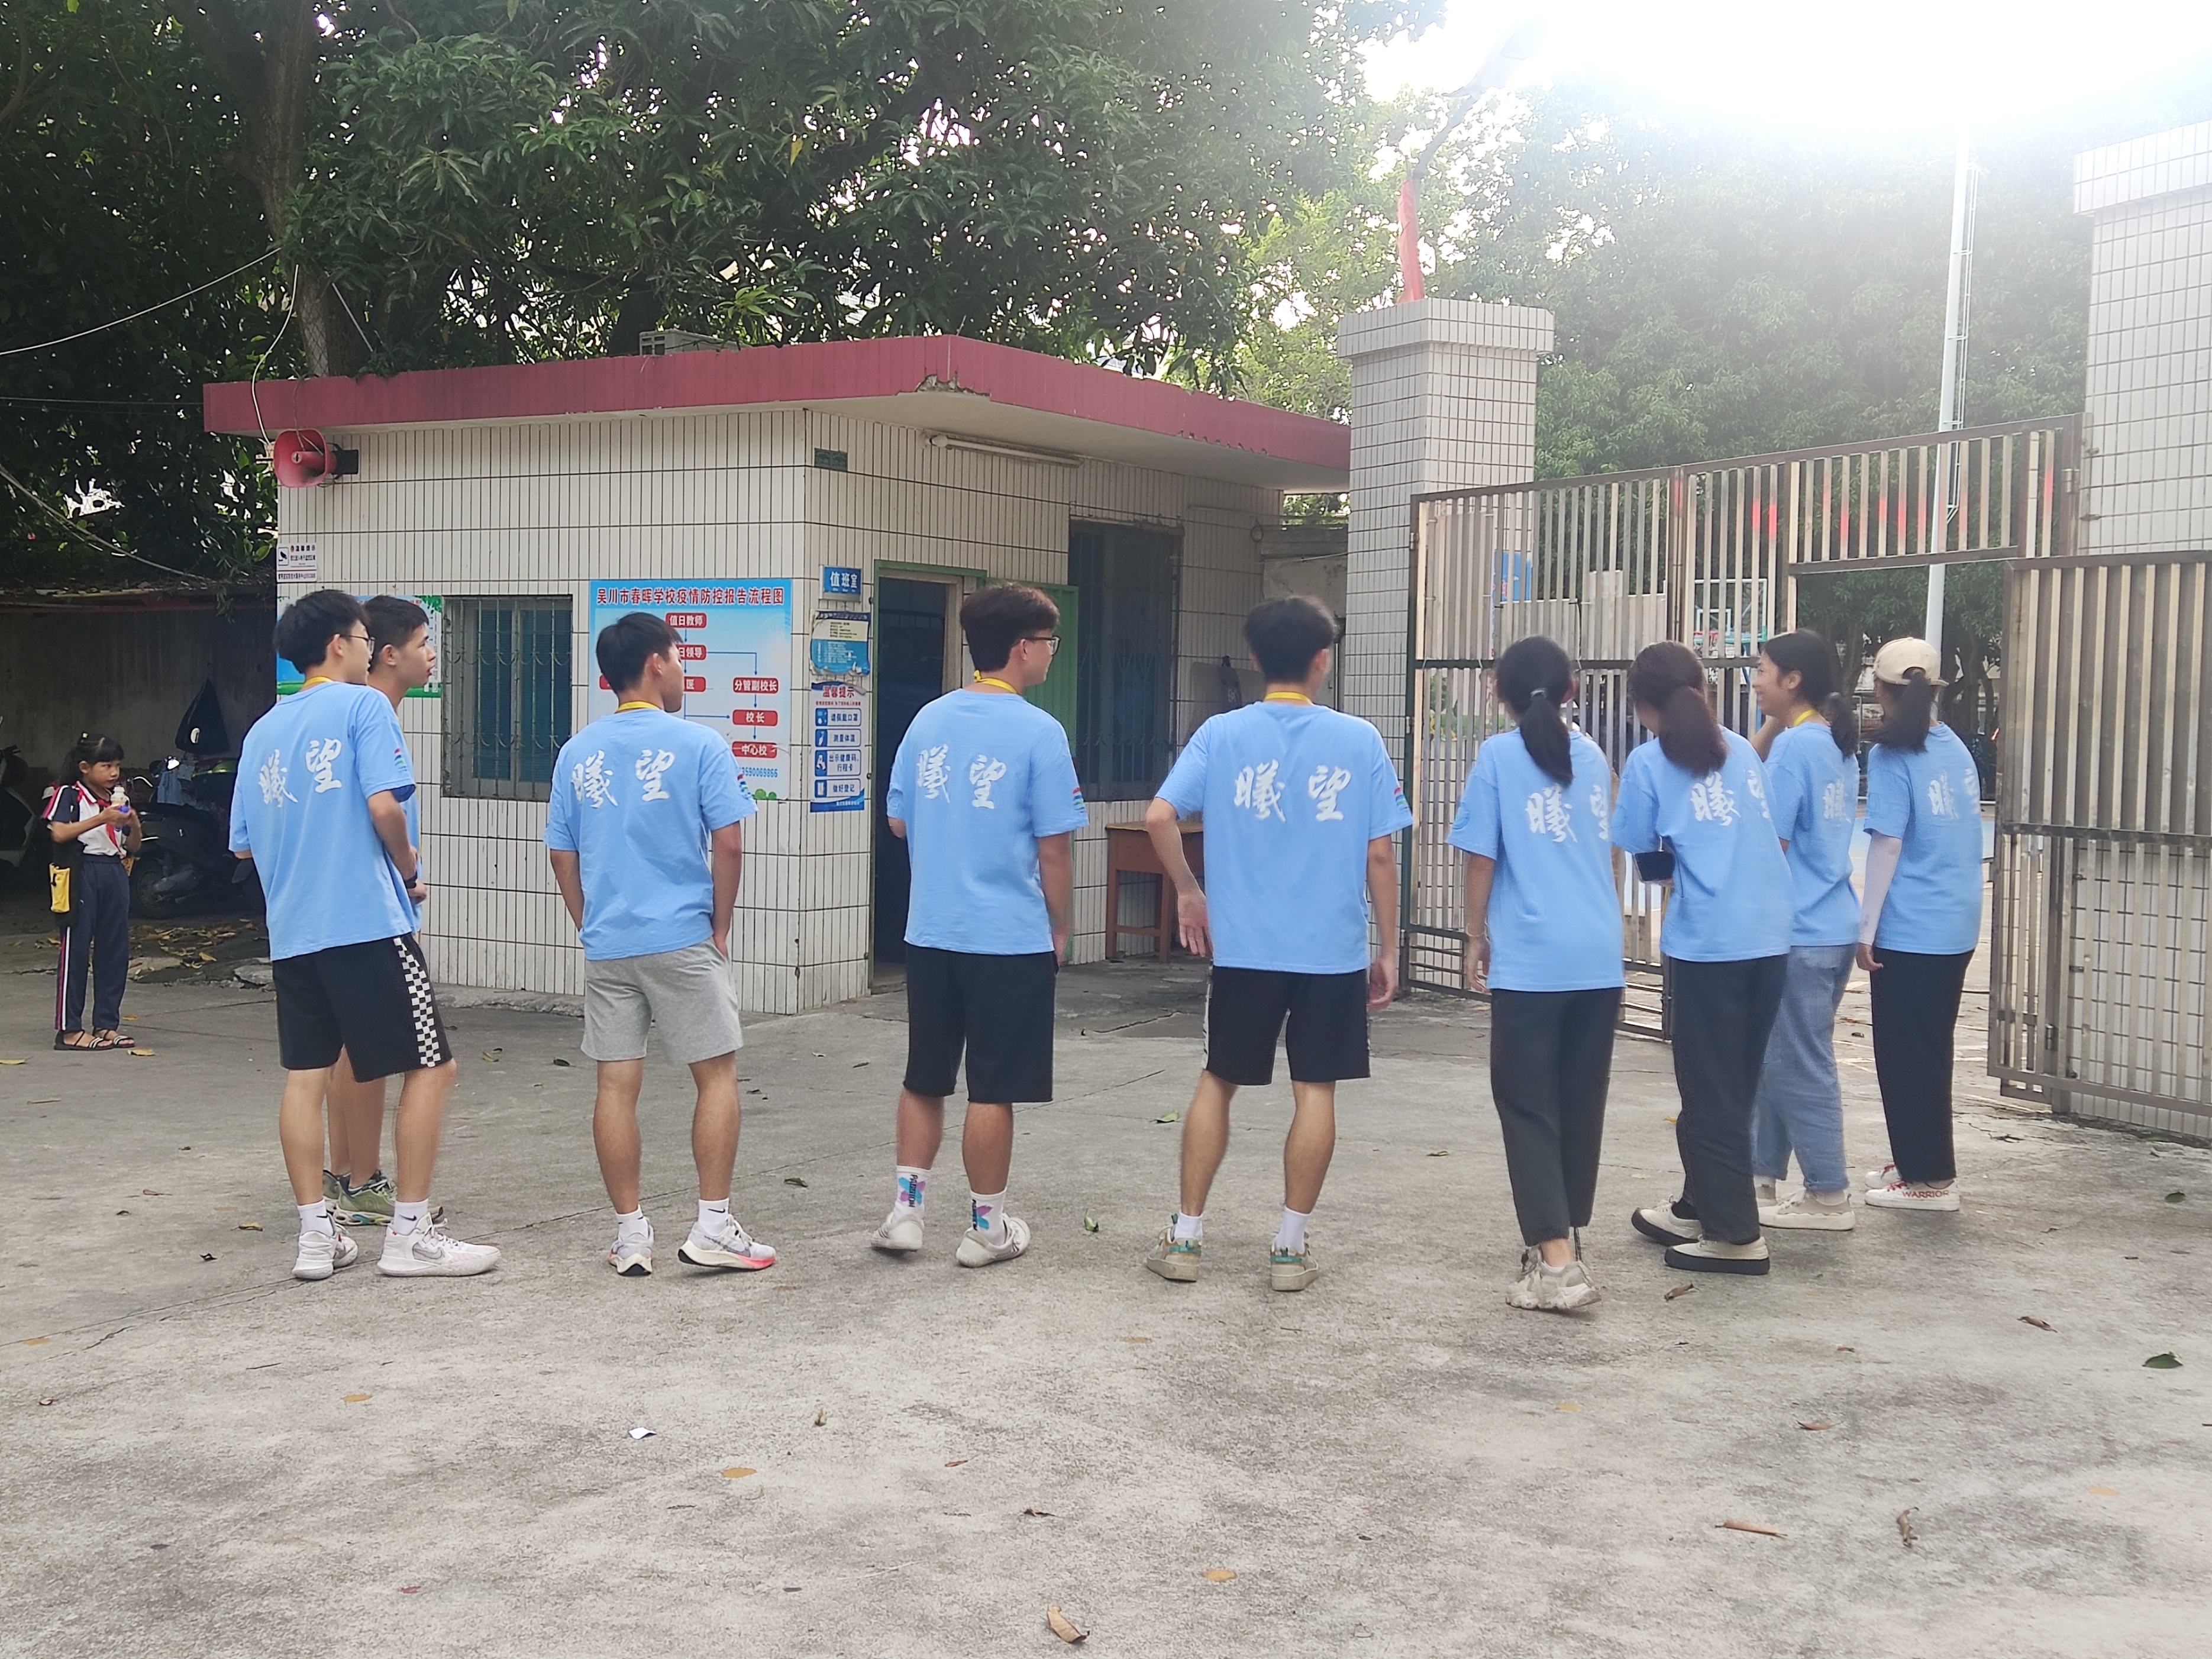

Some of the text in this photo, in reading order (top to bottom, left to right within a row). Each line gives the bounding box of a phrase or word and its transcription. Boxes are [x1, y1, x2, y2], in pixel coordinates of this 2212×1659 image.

[830, 572, 857, 588] 值班室
[597, 588, 784, 605] 吴川市春晖学校疫情防控报告流程图
[670, 615, 703, 627] 值日教师
[678, 647, 702, 658] 日领导
[686, 679, 695, 690] 医
[735, 680, 777, 692] 分管副校长
[823, 686, 854, 698] 温馨提示
[745, 712, 765, 723] 校长
[741, 744, 767, 756] 中心校
[1902, 1190, 1950, 1198] WARRIOR
